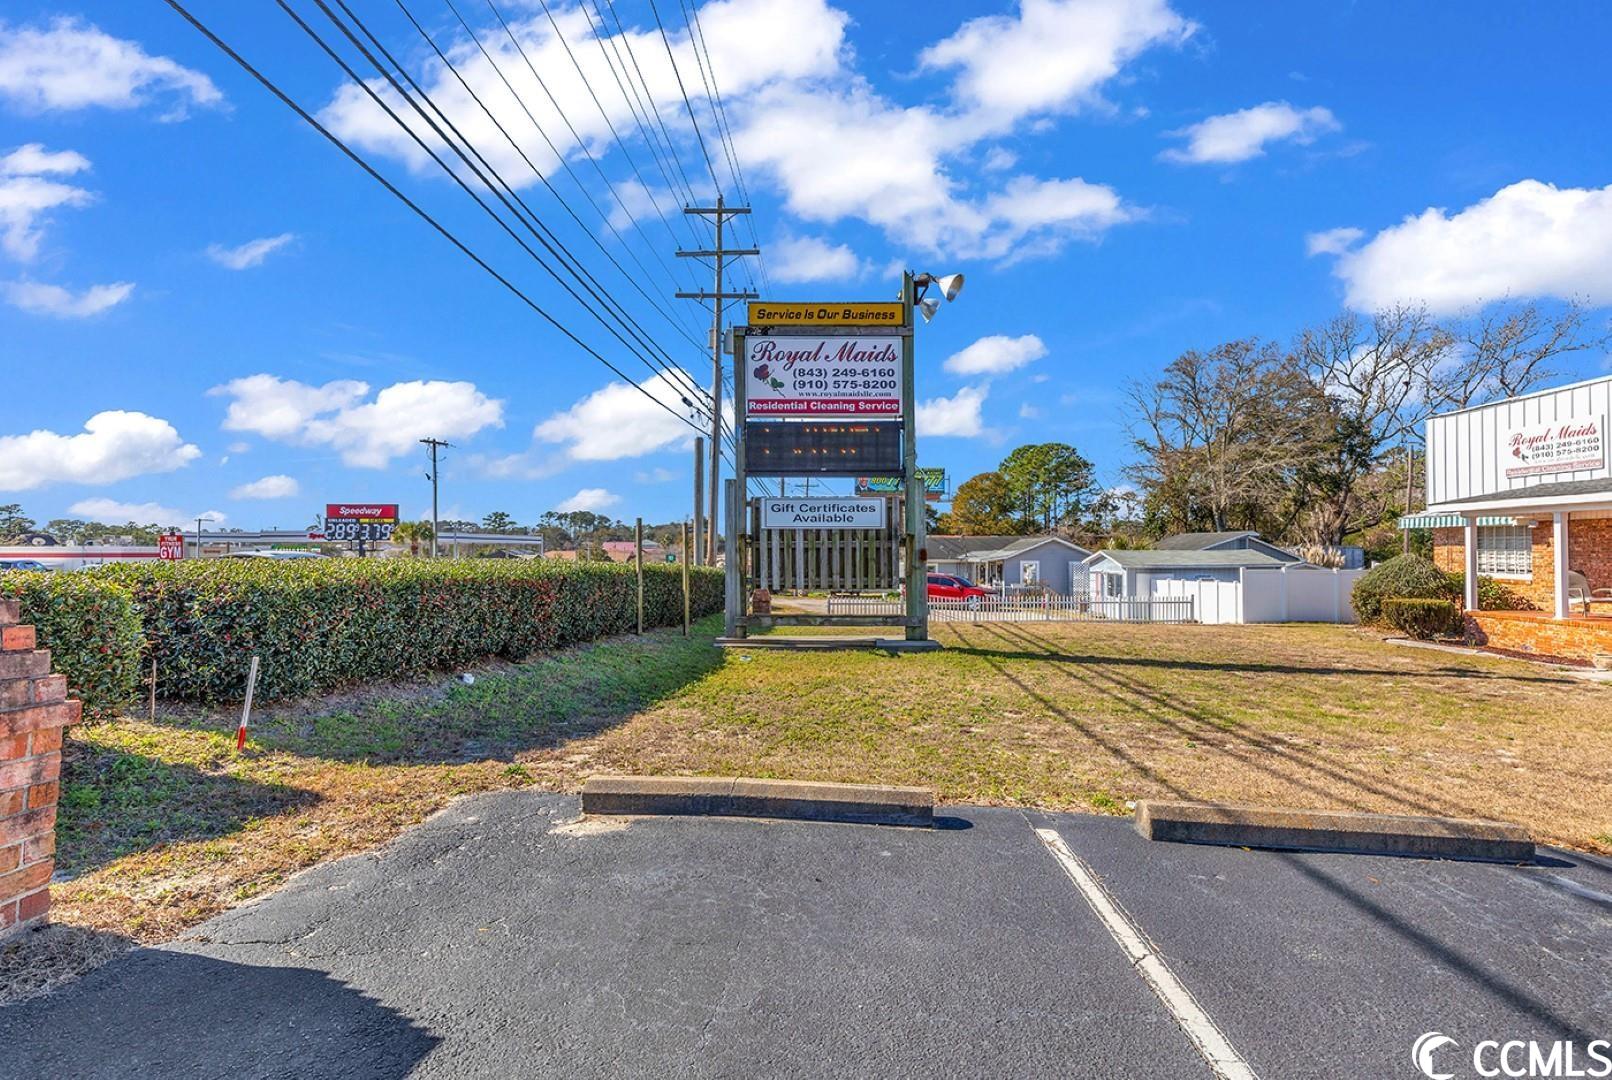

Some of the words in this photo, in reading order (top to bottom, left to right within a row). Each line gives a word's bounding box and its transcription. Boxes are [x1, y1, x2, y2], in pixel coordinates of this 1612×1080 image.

[757, 309, 800, 319] Service
[804, 309, 814, 319] Is
[817, 309, 839, 319] Our
[842, 309, 895, 319] Business
[751, 340, 825, 371] Royal
[824, 341, 898, 362] Maids
[793, 368, 828, 378] (843)
[832, 368, 895, 377] 249-6160
[793, 380, 828, 390] (910)
[833, 380, 896, 389] 575-8200
[749, 401, 807, 410] Residential
[810, 401, 855, 411] Cleaning
[858, 401, 898, 410] Service
[1509, 428, 1551, 450] Royal
[1551, 422, 1597, 440] Maids
[1532, 444, 1554, 452] (843)
[1556, 437, 1600, 449] 249-6160
[1532, 451, 1554, 460] (910)
[1556, 445, 1600, 457] 575-8200
[339, 506, 382, 516] Speedway
[771, 503, 794, 513] Gift
[799, 503, 876, 513] Certificates
[793, 514, 854, 523] Available
[160, 546, 182, 558] GYM
